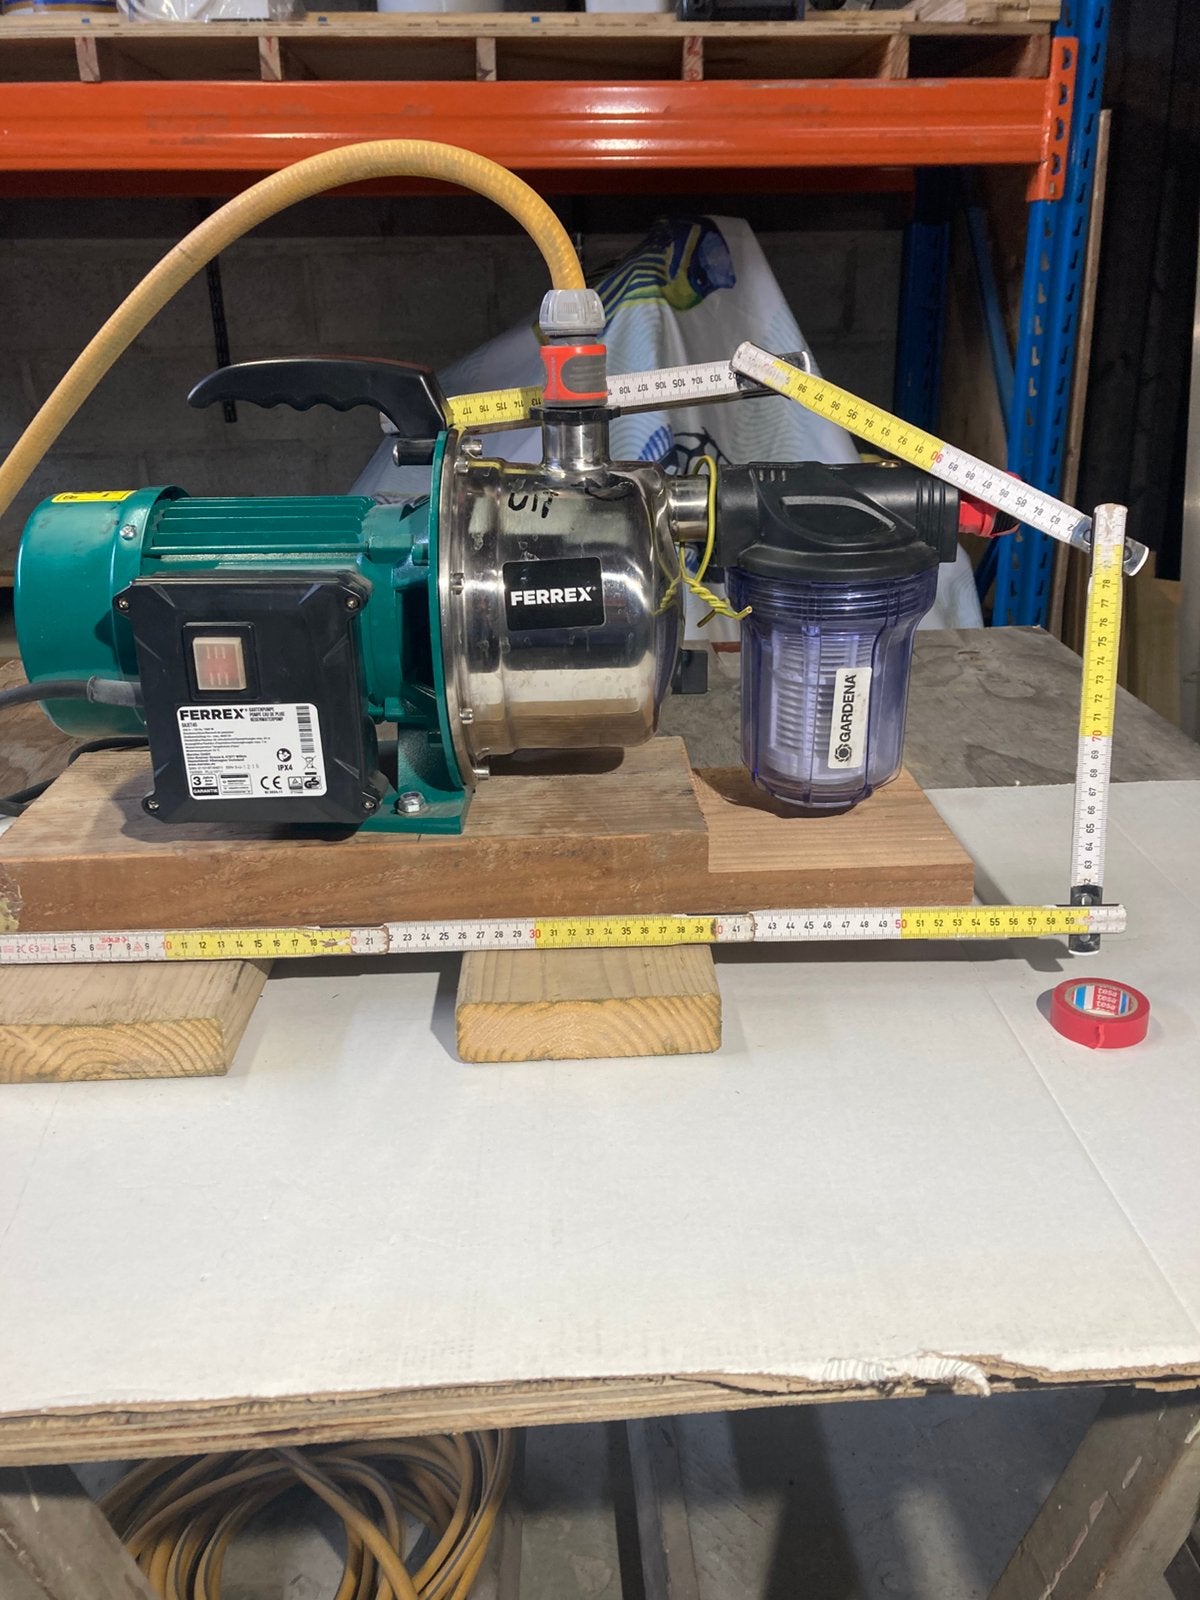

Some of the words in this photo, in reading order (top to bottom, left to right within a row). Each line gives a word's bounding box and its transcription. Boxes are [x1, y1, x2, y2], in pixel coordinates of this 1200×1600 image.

[692, 376, 703, 385] 104
[710, 374, 722, 382] 103
[655, 381, 666, 389] 106
[672, 378, 686, 388] 105
[619, 386, 631, 394] 108
[638, 384, 648, 392] 107
[798, 383, 807, 393] 98
[814, 392, 824, 402] 97
[496, 402, 507, 411] 115
[532, 398, 542, 406] 113
[831, 401, 840, 410] 96
[462, 406, 472, 415] 117
[479, 404, 489, 413] 116
[847, 409, 858, 420] 95
[865, 418, 873, 428] 94
[881, 427, 890, 436] 93
[898, 436, 907, 445] 92
[915, 444, 924, 454] 91
[931, 450, 943, 463] 90
[948, 462, 958, 471] 89
[965, 471, 975, 480] 88
[982, 480, 992, 489] 87
[999, 489, 1009, 498] 86
[1016, 497, 1027, 508] 85
[1034, 506, 1044, 516] 84
[1051, 515, 1060, 524] 83
[1102, 579, 1110, 588] 78
[510, 586, 592, 606] FERREX
[1101, 598, 1109, 607] 77
[1100, 618, 1108, 627] 76
[1098, 636, 1107, 646] 75
[1097, 656, 1105, 665] 74
[1096, 675, 1104, 684] 73
[1095, 694, 1103, 703] 72
[840, 674, 856, 742] GARDENA
[179, 708, 245, 720] FERREX
[1093, 713, 1101, 721] 71
[1092, 730, 1102, 742] 70
[1091, 750, 1099, 759] 69
[1090, 769, 1098, 778] 68
[193, 776, 202, 785] 3
[1089, 787, 1096, 796] 67
[1088, 806, 1095, 815] 66
[1086, 823, 1095, 834] 65
[1085, 842, 1093, 851] 64
[1084, 860, 1092, 869] 63
[162, 940, 172, 950] 10
[440, 932, 449, 940] 25
[529, 929, 541, 938] 30
[622, 927, 631, 935] 35
[804, 921, 814, 929] 45
[895, 919, 908, 929] 50
[990, 918, 1000, 926] 55
[1098, 988, 1117, 997] tesa
[1097, 995, 1116, 1004] tesa
[1096, 1001, 1116, 1010] tesa
